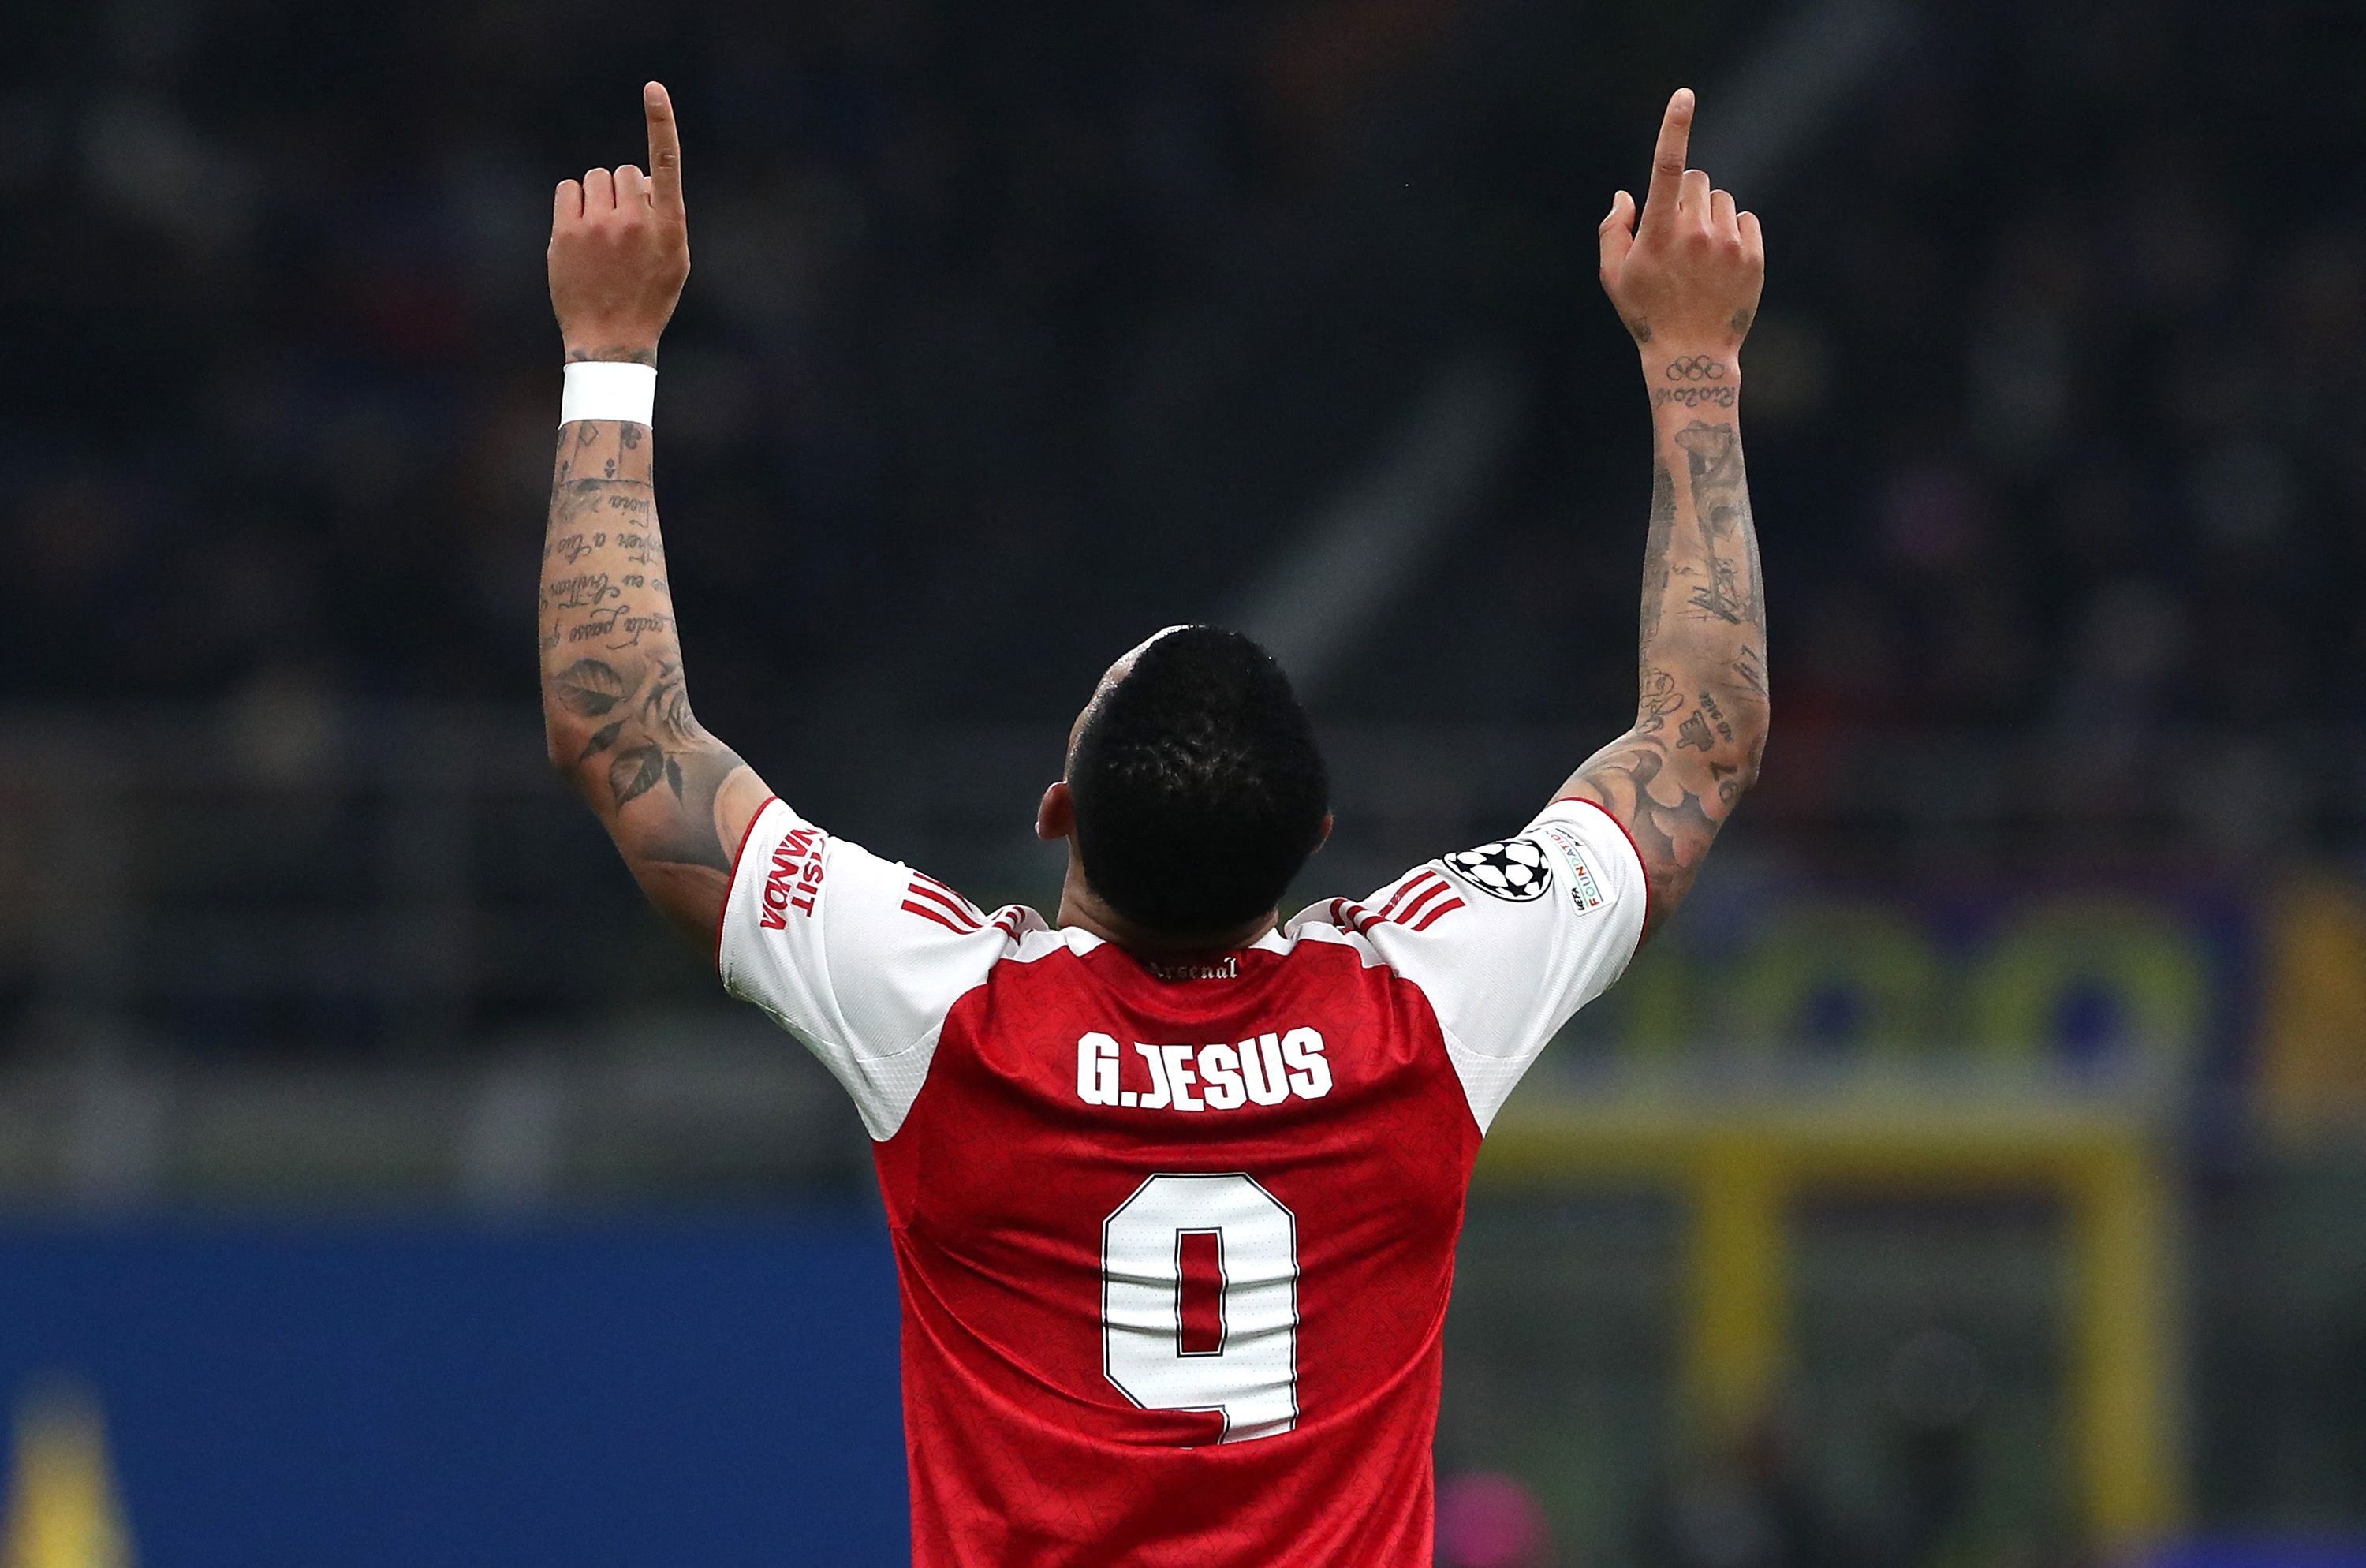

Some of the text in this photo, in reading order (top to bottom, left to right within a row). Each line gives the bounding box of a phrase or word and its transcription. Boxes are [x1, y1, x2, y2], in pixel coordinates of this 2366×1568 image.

[1545, 831, 1600, 907] FOUNDATIO
[1571, 887, 1585, 911] UEFA
[1076, 1026, 1334, 1111] G.JESUS
[1101, 1172, 1301, 1447] 9
